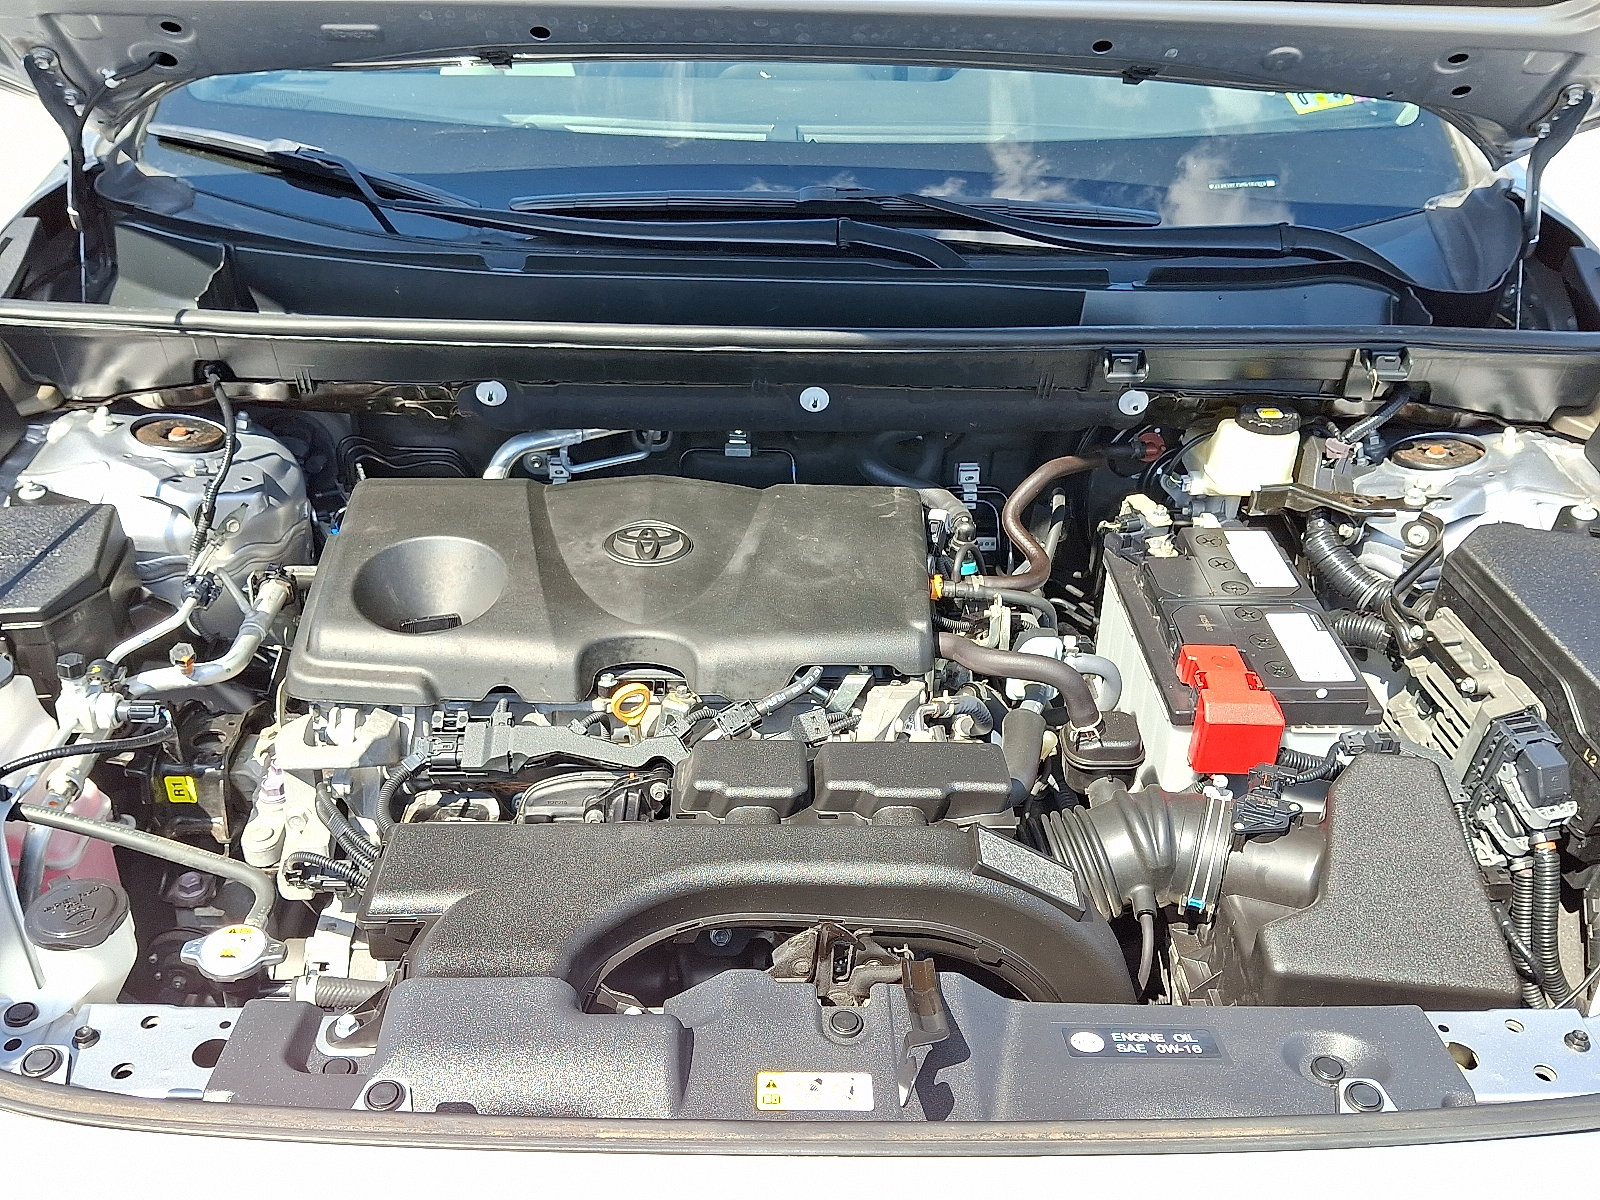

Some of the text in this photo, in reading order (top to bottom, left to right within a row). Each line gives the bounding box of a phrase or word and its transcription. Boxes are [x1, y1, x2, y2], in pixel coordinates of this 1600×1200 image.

[1583, 747, 1598, 768] L2
[171, 782, 186, 797] R1
[1110, 1032, 1166, 1043] ENGINE
[1172, 1033, 1199, 1043] OIL
[1115, 1043, 1203, 1054] SAE 0W-16
